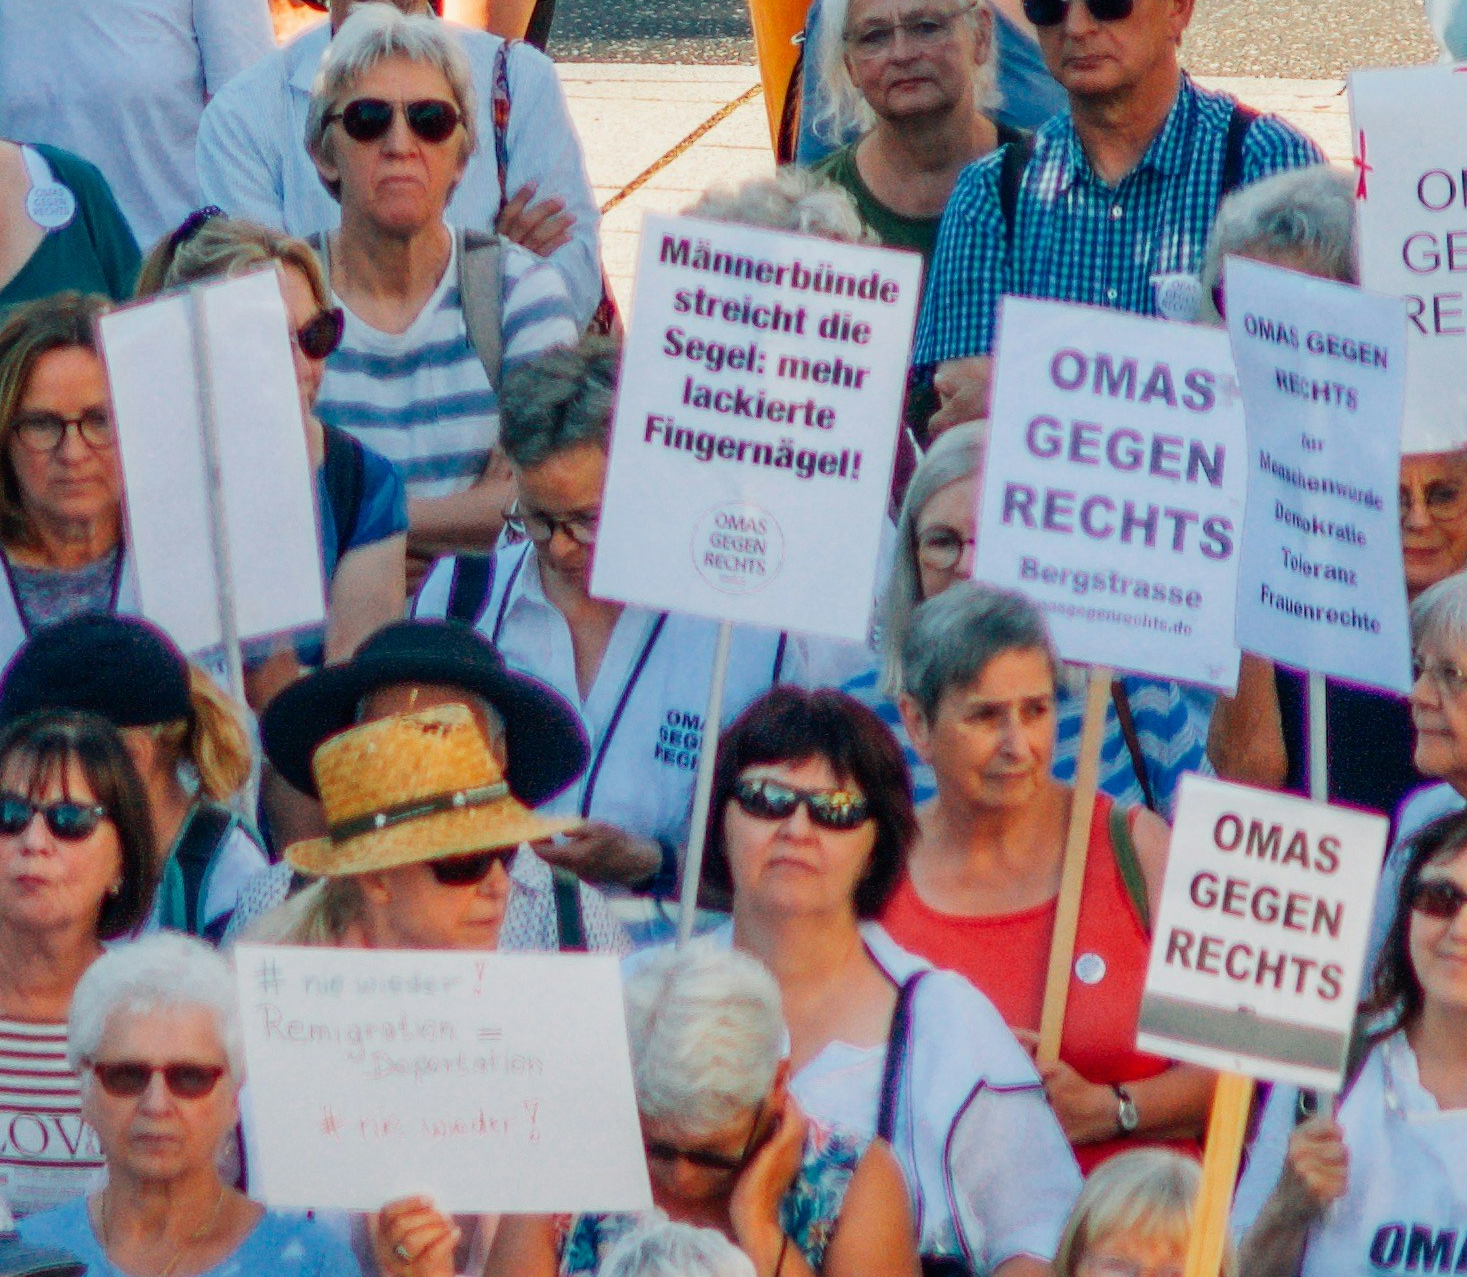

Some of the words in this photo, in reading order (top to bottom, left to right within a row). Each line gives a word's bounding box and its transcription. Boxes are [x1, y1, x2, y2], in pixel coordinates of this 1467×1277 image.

[658, 234, 901, 306] Männerbünde
[672, 290, 807, 341] streicht
[817, 313, 873, 347] die
[1244, 311, 1300, 351] OMAS
[1305, 330, 1389, 371] GEGEN
[662, 326, 767, 378] Segel:
[776, 356, 872, 391] mehr
[1049, 347, 1218, 414] OMAS
[681, 375, 837, 431] lackierte
[1274, 366, 1360, 413] RECHTS
[642, 413, 863, 481] Fingernägel!
[1025, 413, 1228, 489] GEGEN
[1259, 451, 1384, 512] Menschenwürde
[708, 532, 768, 556] GEGEN
[713, 510, 768, 535] OMAS
[1001, 480, 1235, 563] RECHTS
[1274, 501, 1368, 548] Demokratie
[703, 551, 768, 576] RECHTS
[1018, 555, 1203, 611] Bergstrasse
[1280, 546, 1358, 587] Toleranz
[1260, 583, 1382, 635] Frauenrechte
[1213, 812, 1344, 875] OMAS
[1189, 870, 1345, 940] GEGEN
[1165, 928, 1345, 1002] RECHTS
